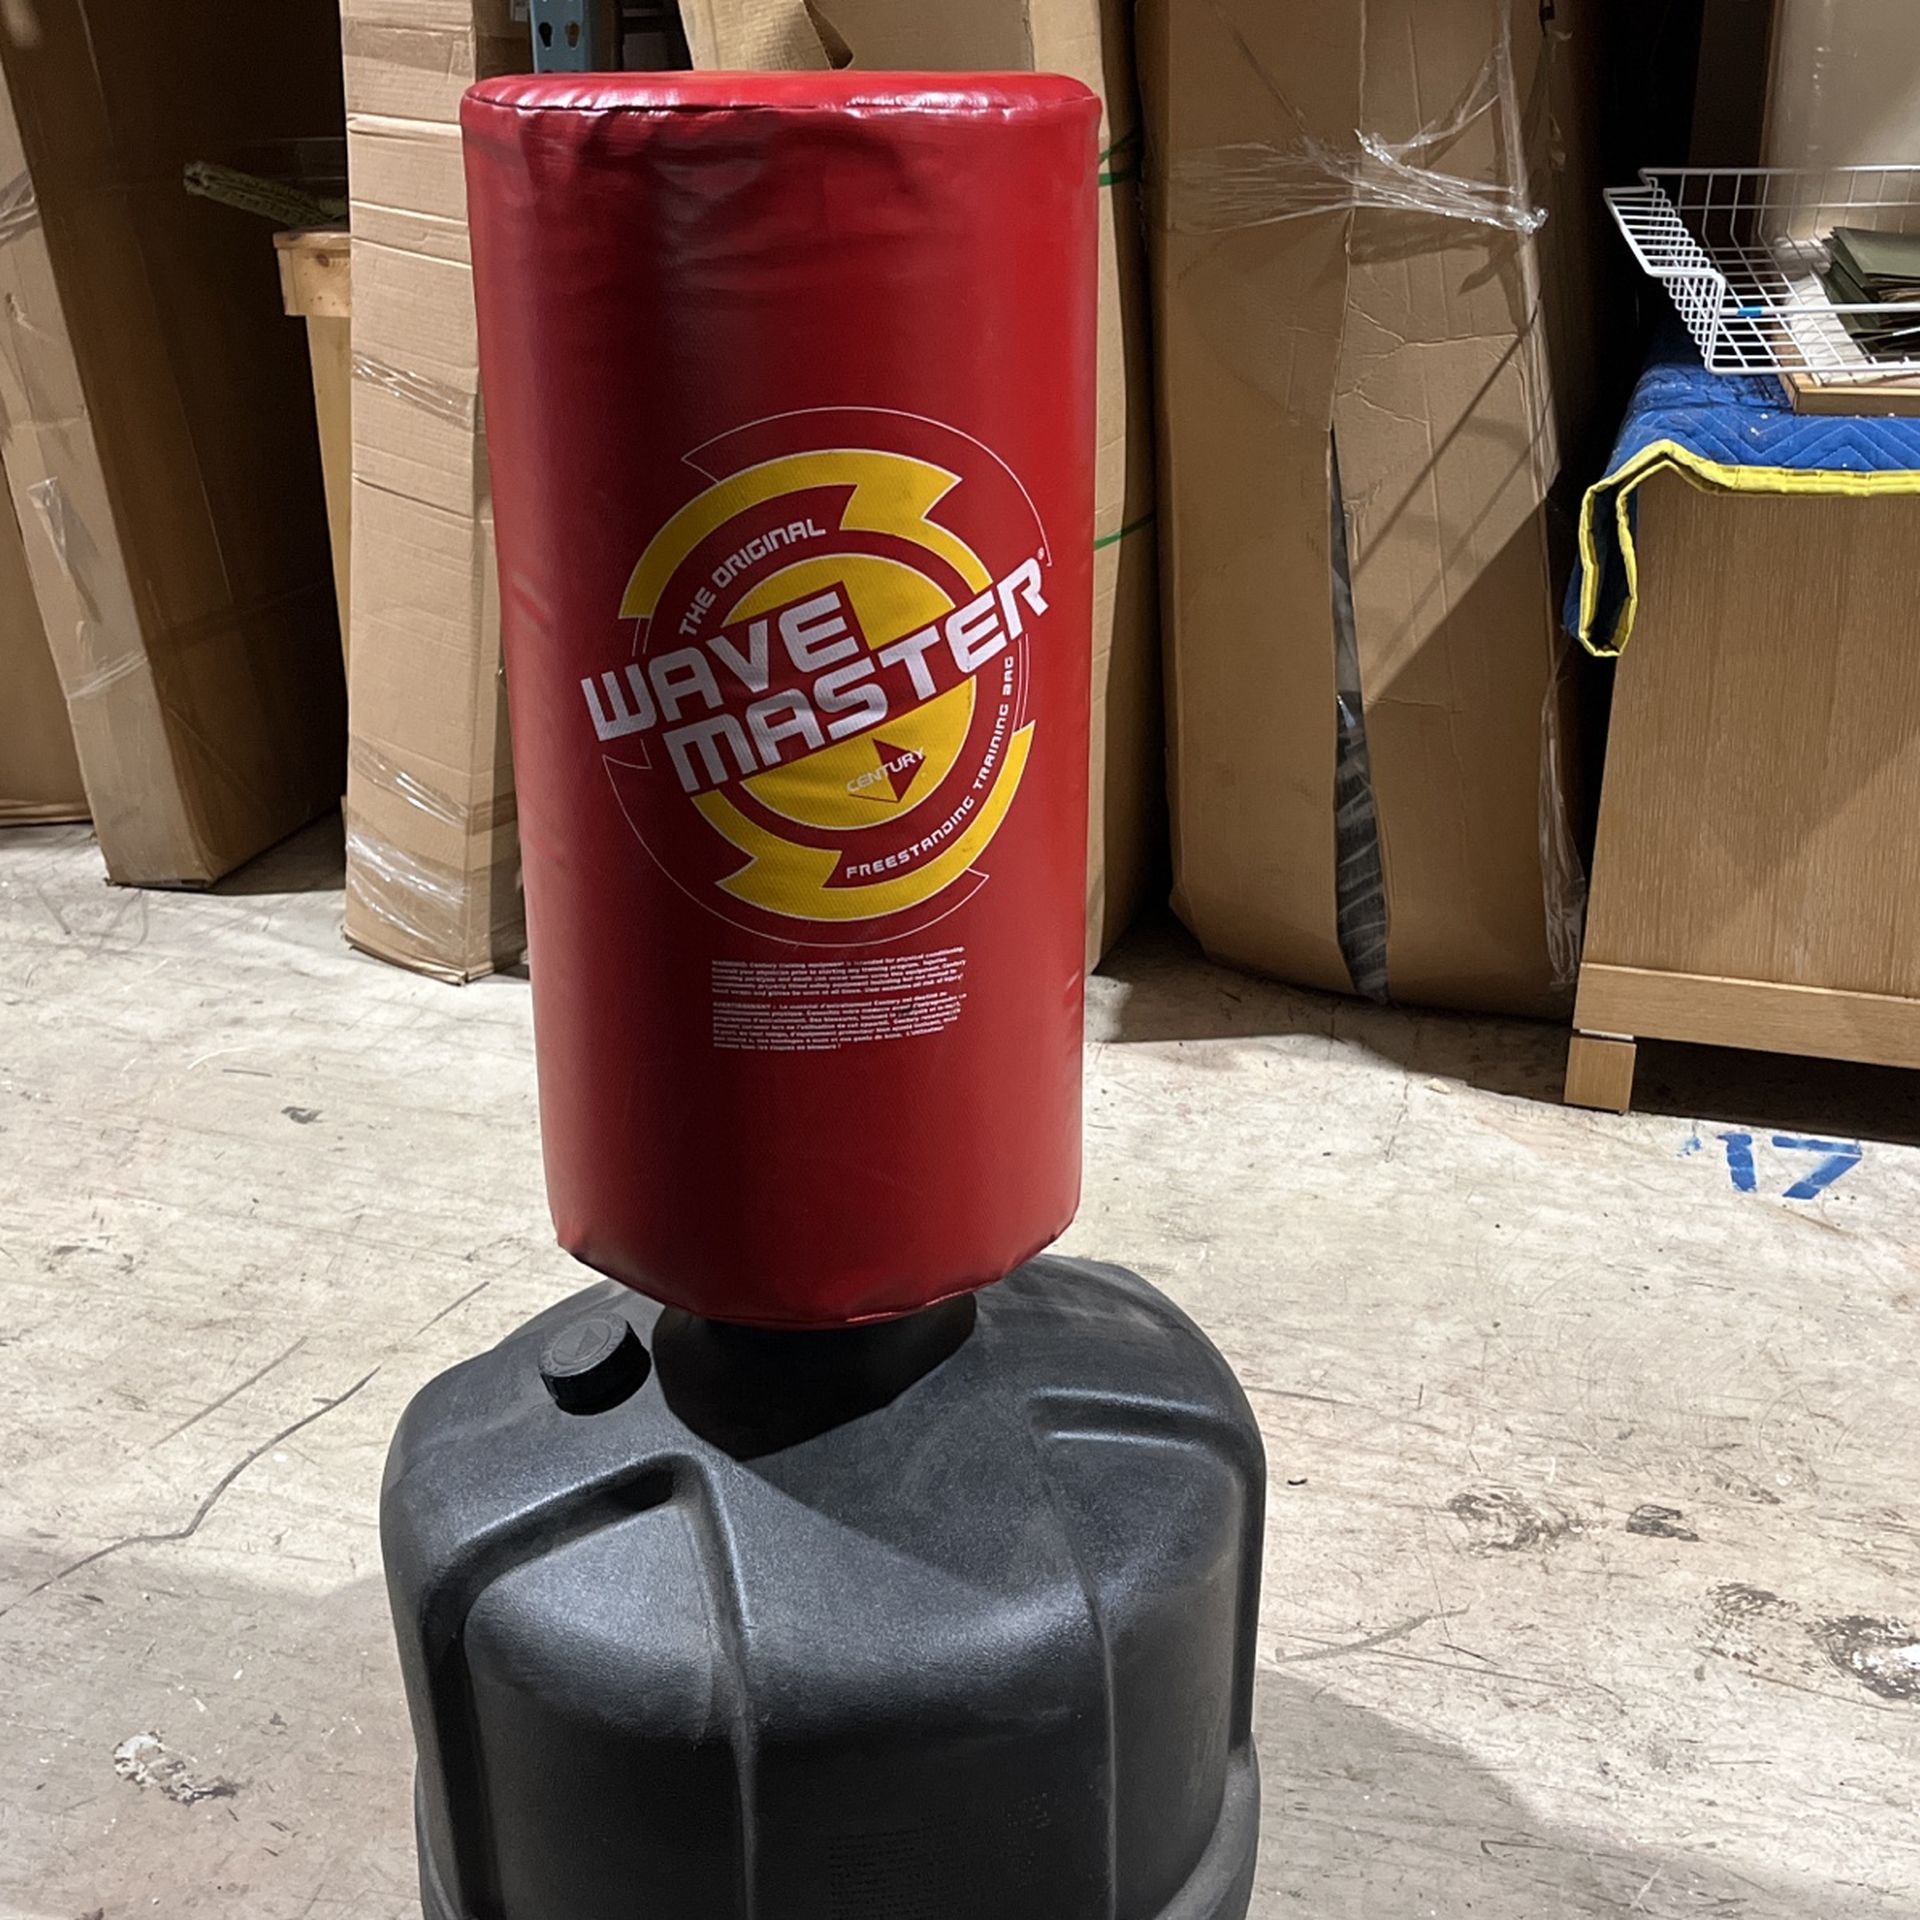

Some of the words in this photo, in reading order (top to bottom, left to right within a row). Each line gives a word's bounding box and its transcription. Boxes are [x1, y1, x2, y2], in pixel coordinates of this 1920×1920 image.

[678, 585, 717, 636] THE
[711, 517, 827, 587] ORIGINAL
[580, 591, 860, 742] WAVE
[846, 795, 976, 879] FREESTANDING
[972, 703, 1010, 791] TRAINING
[1001, 655, 1015, 696] BAG
[847, 747, 925, 793] CENTURY
[1716, 1131, 1862, 1200] 17
